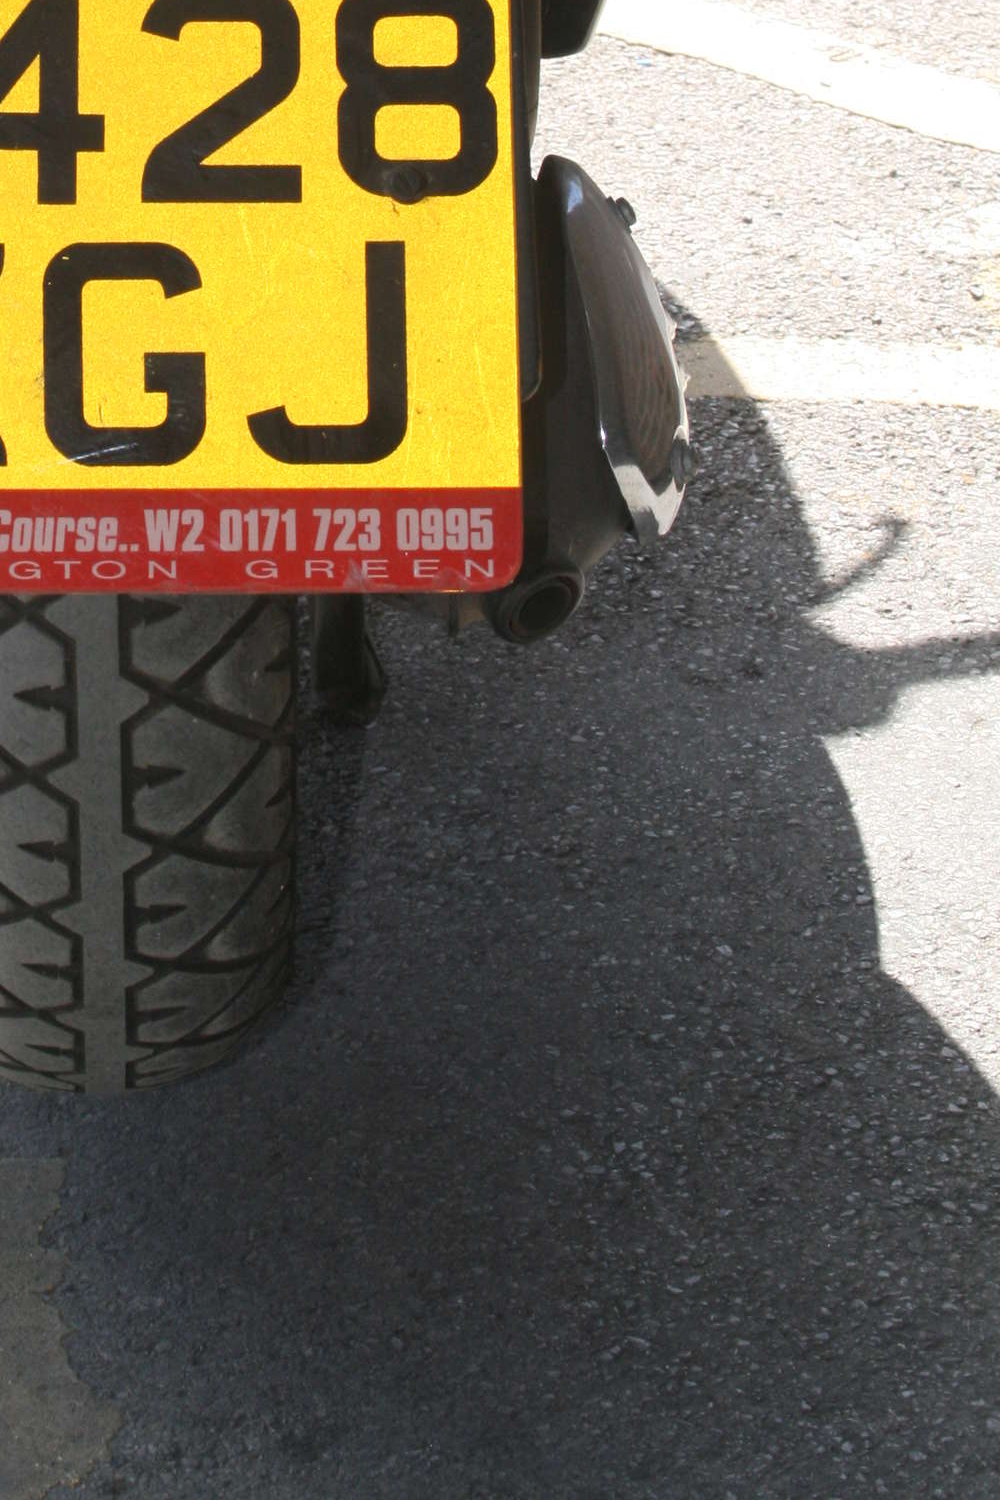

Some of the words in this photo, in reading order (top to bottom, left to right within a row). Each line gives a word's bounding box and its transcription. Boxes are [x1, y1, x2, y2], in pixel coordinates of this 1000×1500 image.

[219, 508, 298, 553] 0171
[313, 508, 383, 552] 723
[396, 507, 495, 552] 0995
[245, 559, 496, 580] GREEN
